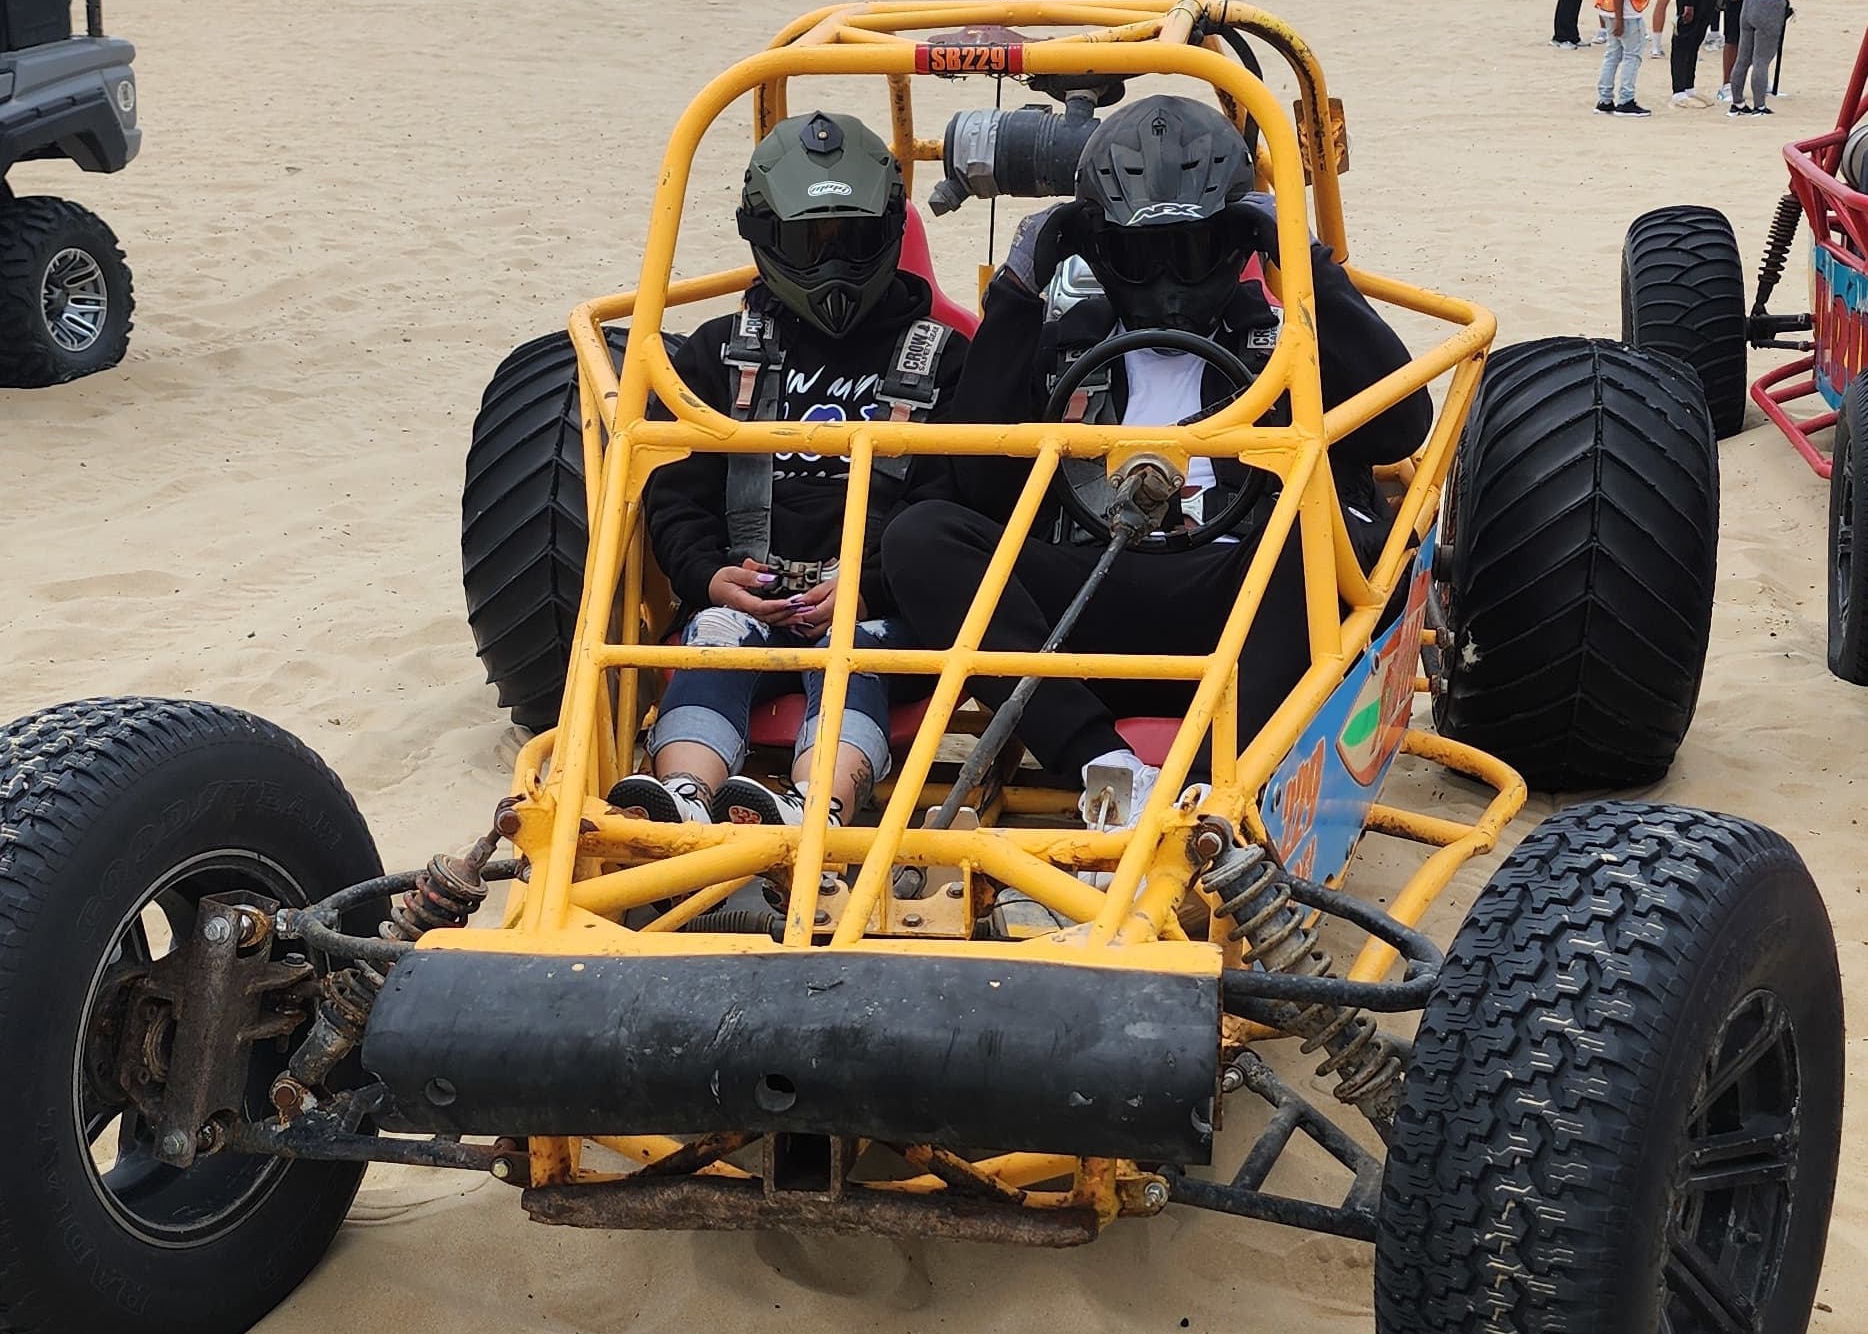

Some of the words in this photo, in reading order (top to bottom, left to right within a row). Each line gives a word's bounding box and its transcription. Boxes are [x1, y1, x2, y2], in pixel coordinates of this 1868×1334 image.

[931, 47, 1005, 70] SB229
[903, 332, 928, 370] CROW
[919, 342, 932, 371] SAFETY
